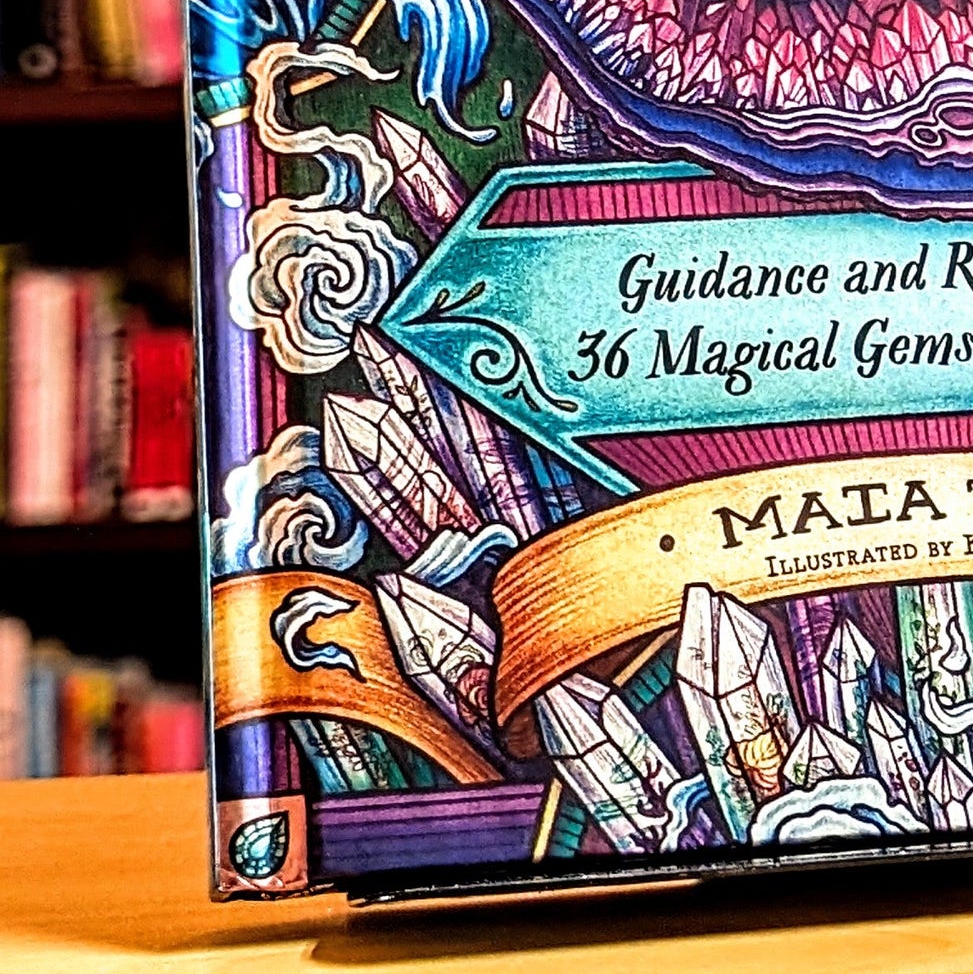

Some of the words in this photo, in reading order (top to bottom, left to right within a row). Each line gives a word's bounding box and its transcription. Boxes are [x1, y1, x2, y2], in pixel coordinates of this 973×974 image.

[618, 251, 829, 314] Guidance
[844, 243, 930, 294] and
[567, 327, 638, 382] 36
[645, 320, 839, 396] Magical
[712, 480, 947, 549] MAIA
[765, 543, 918, 577] ILLUSTRATED
[928, 540, 954, 557] BY
